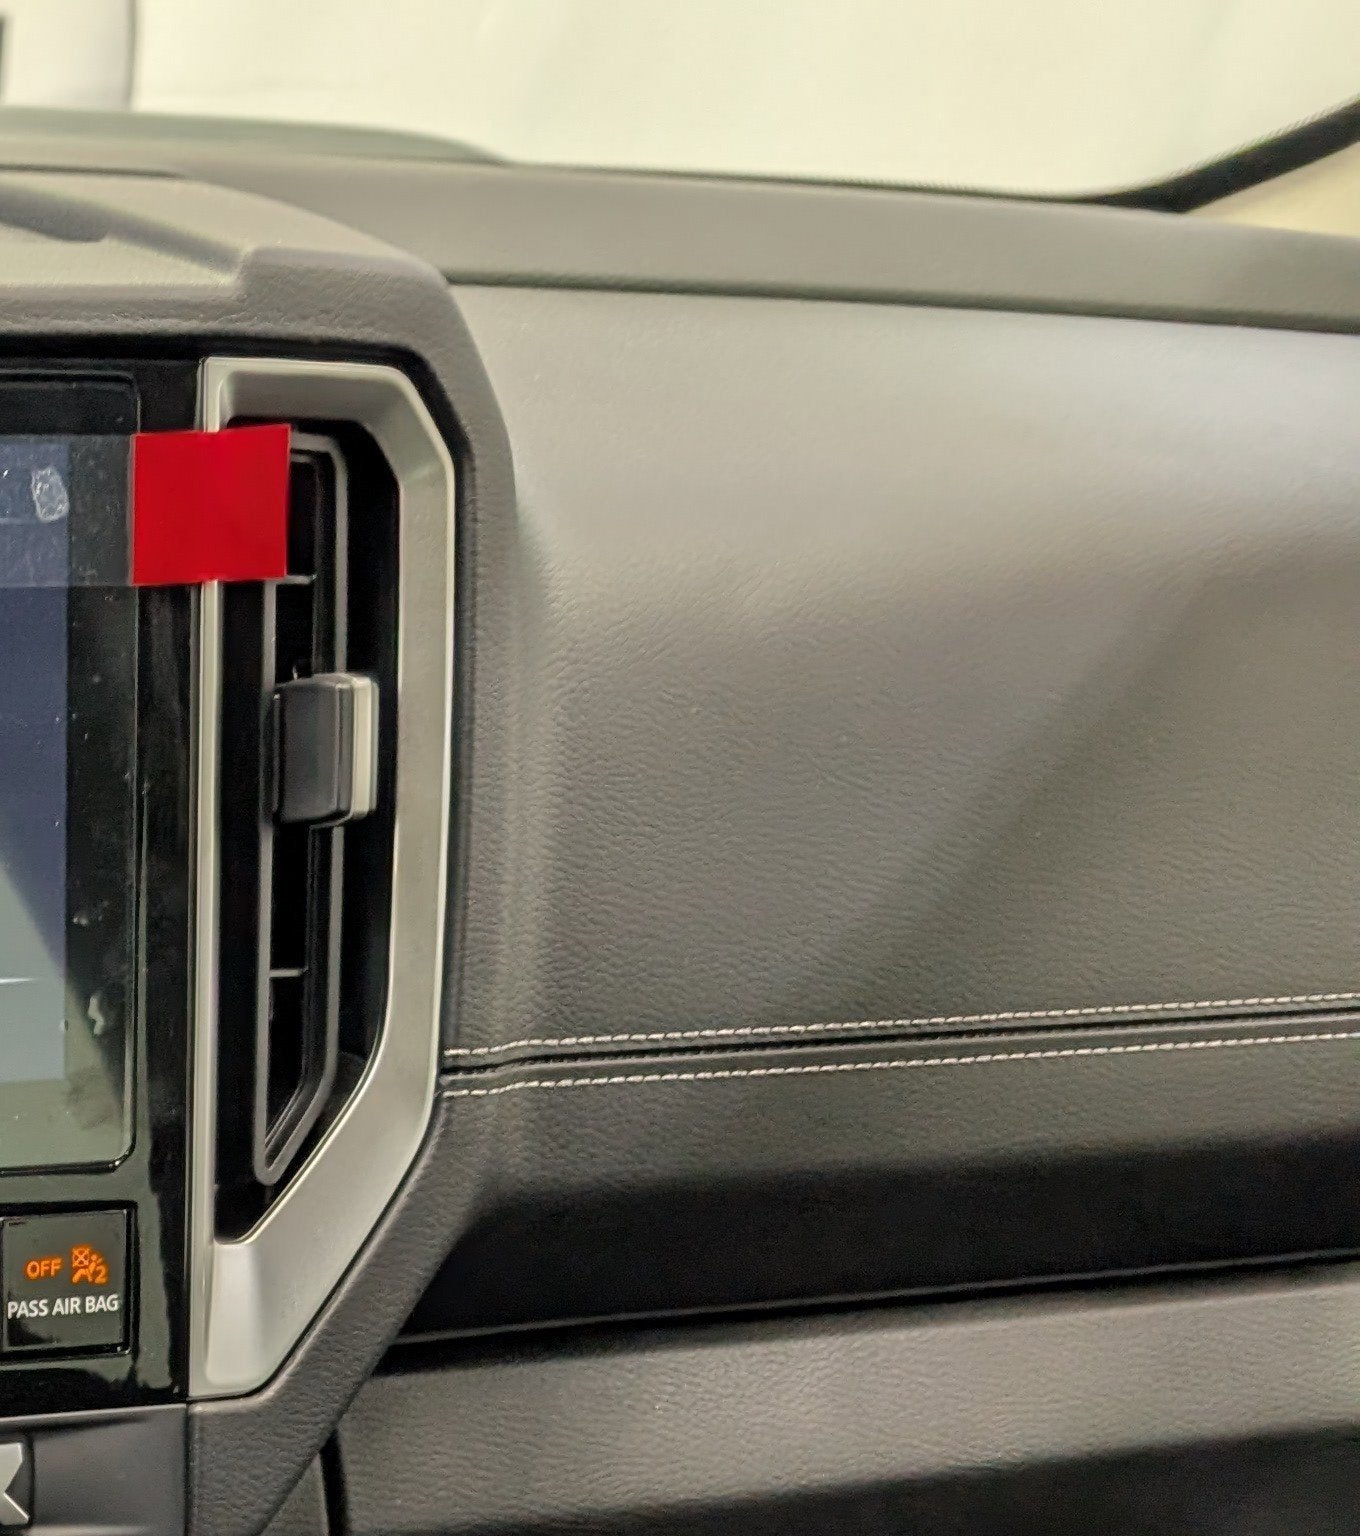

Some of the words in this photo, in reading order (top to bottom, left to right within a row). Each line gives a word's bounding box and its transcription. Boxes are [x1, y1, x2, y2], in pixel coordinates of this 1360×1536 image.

[24, 1258, 63, 1280] OFF
[6, 1299, 49, 1320] PASS
[51, 1297, 82, 1317] AIR
[85, 1294, 120, 1315] BAG
